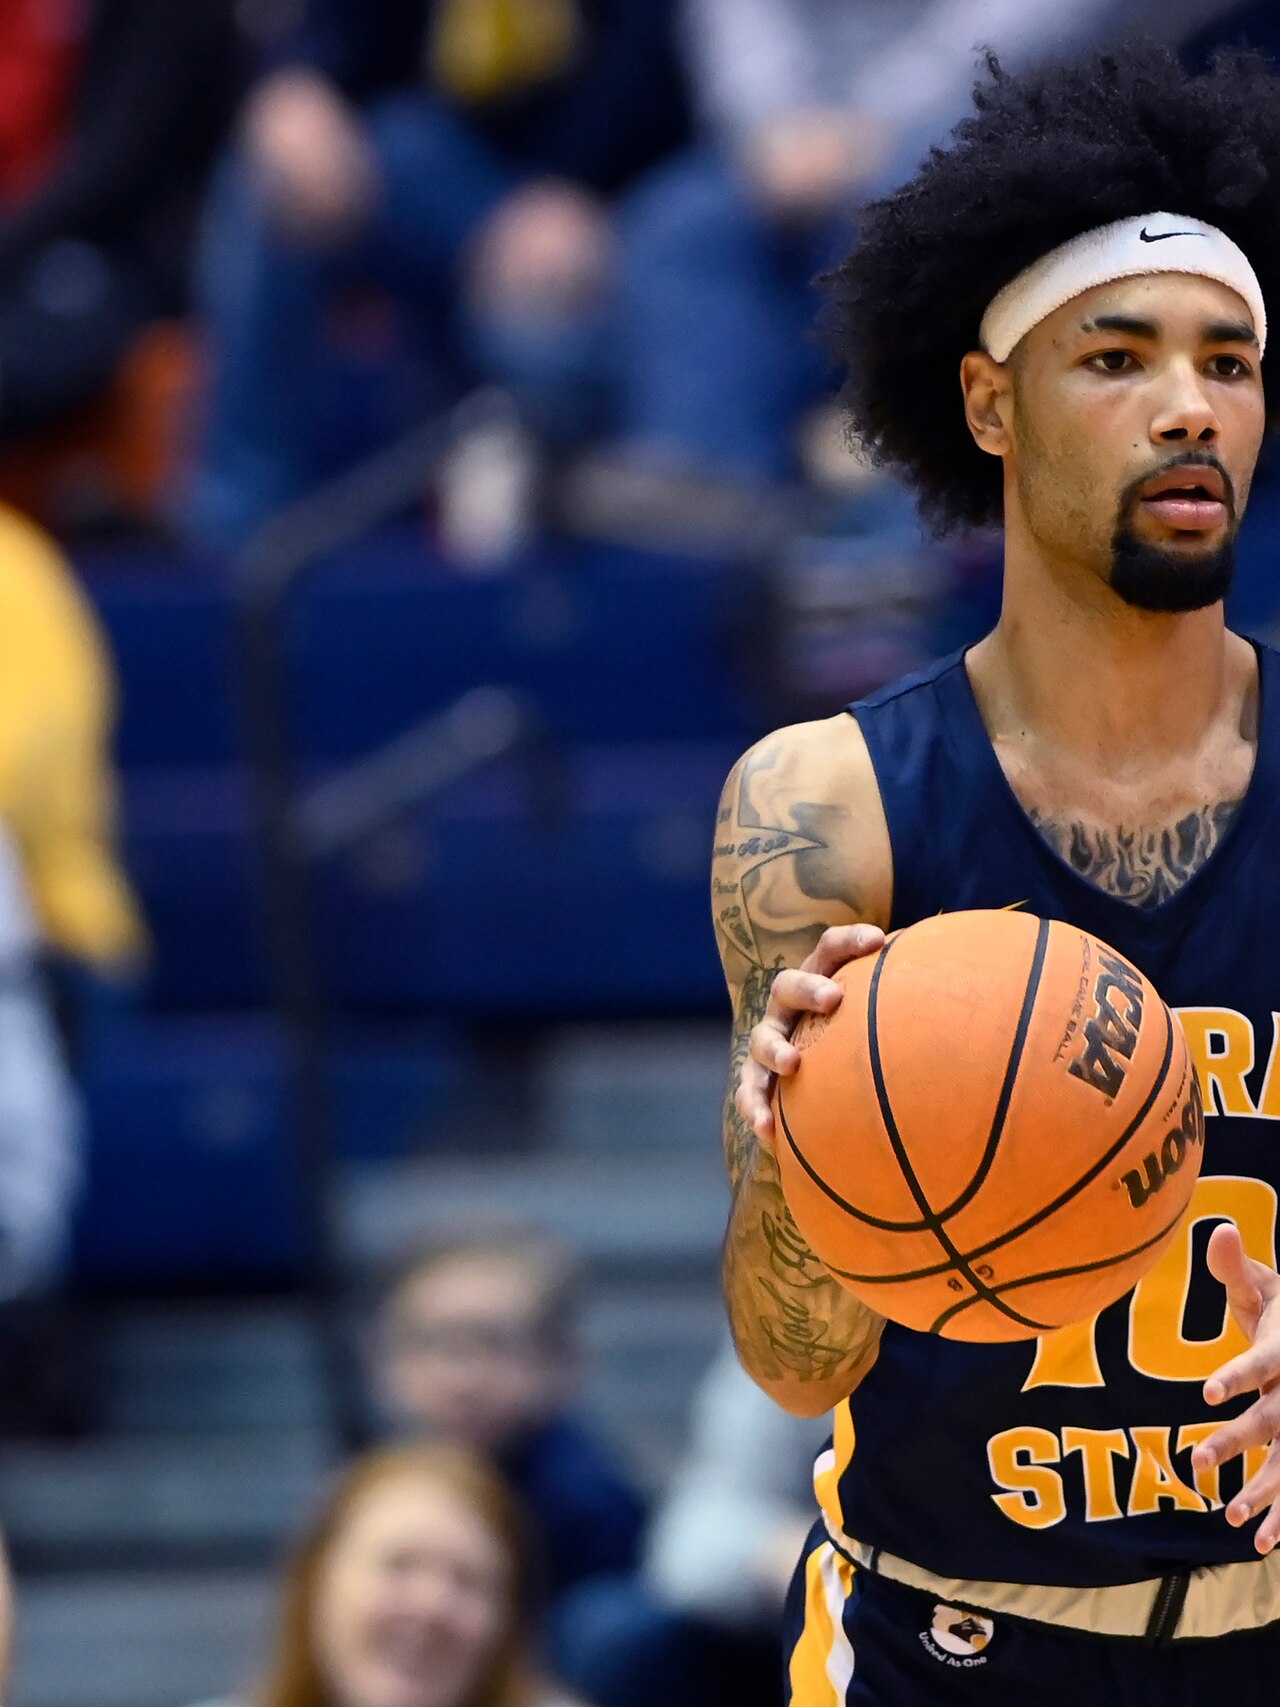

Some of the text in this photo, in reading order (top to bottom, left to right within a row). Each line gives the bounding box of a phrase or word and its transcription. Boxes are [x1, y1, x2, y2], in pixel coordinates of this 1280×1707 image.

[1053, 1020, 1077, 1062] BALL
[1068, 943, 1145, 1100] NCAA
[918, 1631, 988, 1668] United As One
